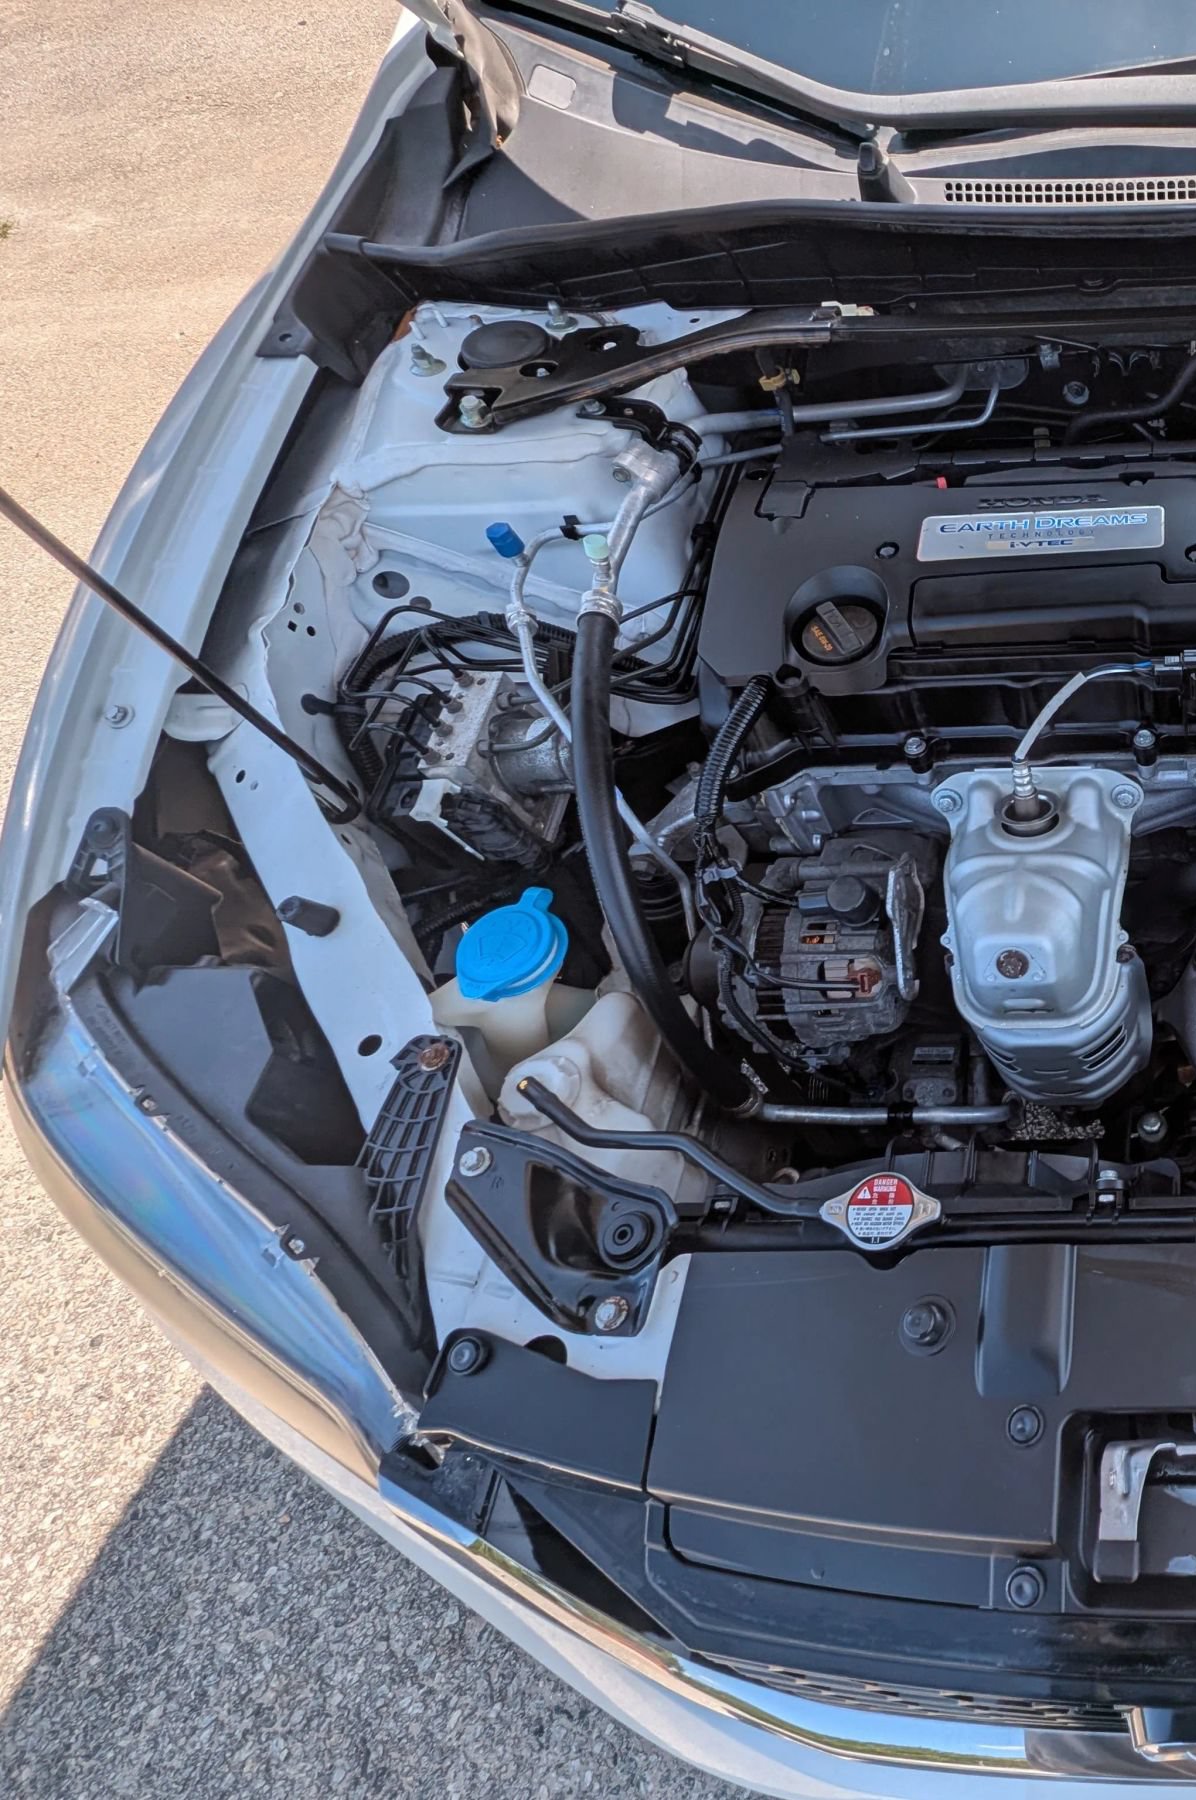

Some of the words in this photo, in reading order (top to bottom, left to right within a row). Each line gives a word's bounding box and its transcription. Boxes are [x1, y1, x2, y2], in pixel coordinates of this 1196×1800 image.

[977, 495, 1108, 509] HONDA
[939, 519, 1029, 533] EARTH
[1035, 513, 1148, 529] DREAMS
[988, 530, 1095, 540] TECHNOLOGY
[873, 1178, 898, 1186] DANGER
